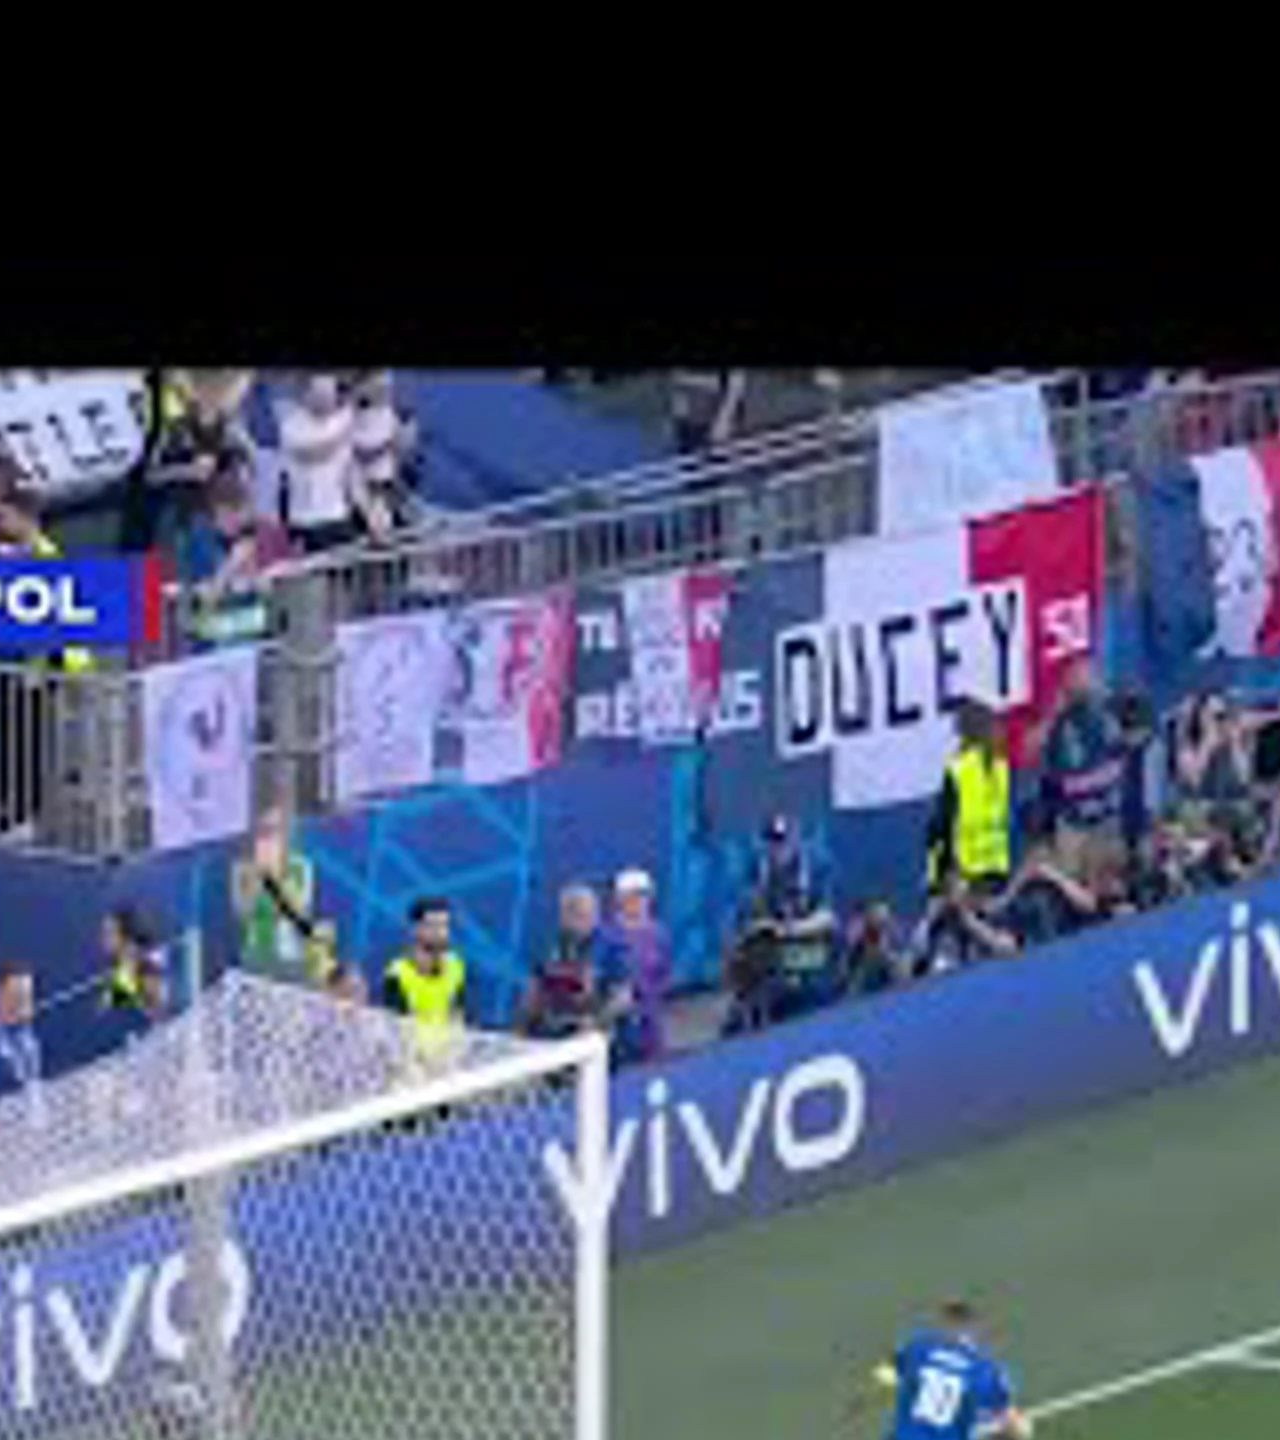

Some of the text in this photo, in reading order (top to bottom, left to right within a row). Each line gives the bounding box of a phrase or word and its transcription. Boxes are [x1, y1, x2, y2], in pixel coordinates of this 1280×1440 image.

[782, 590, 1020, 746] DUCEY
[542, 1053, 866, 1224] vivo
[910, 1364, 964, 1428] 10
